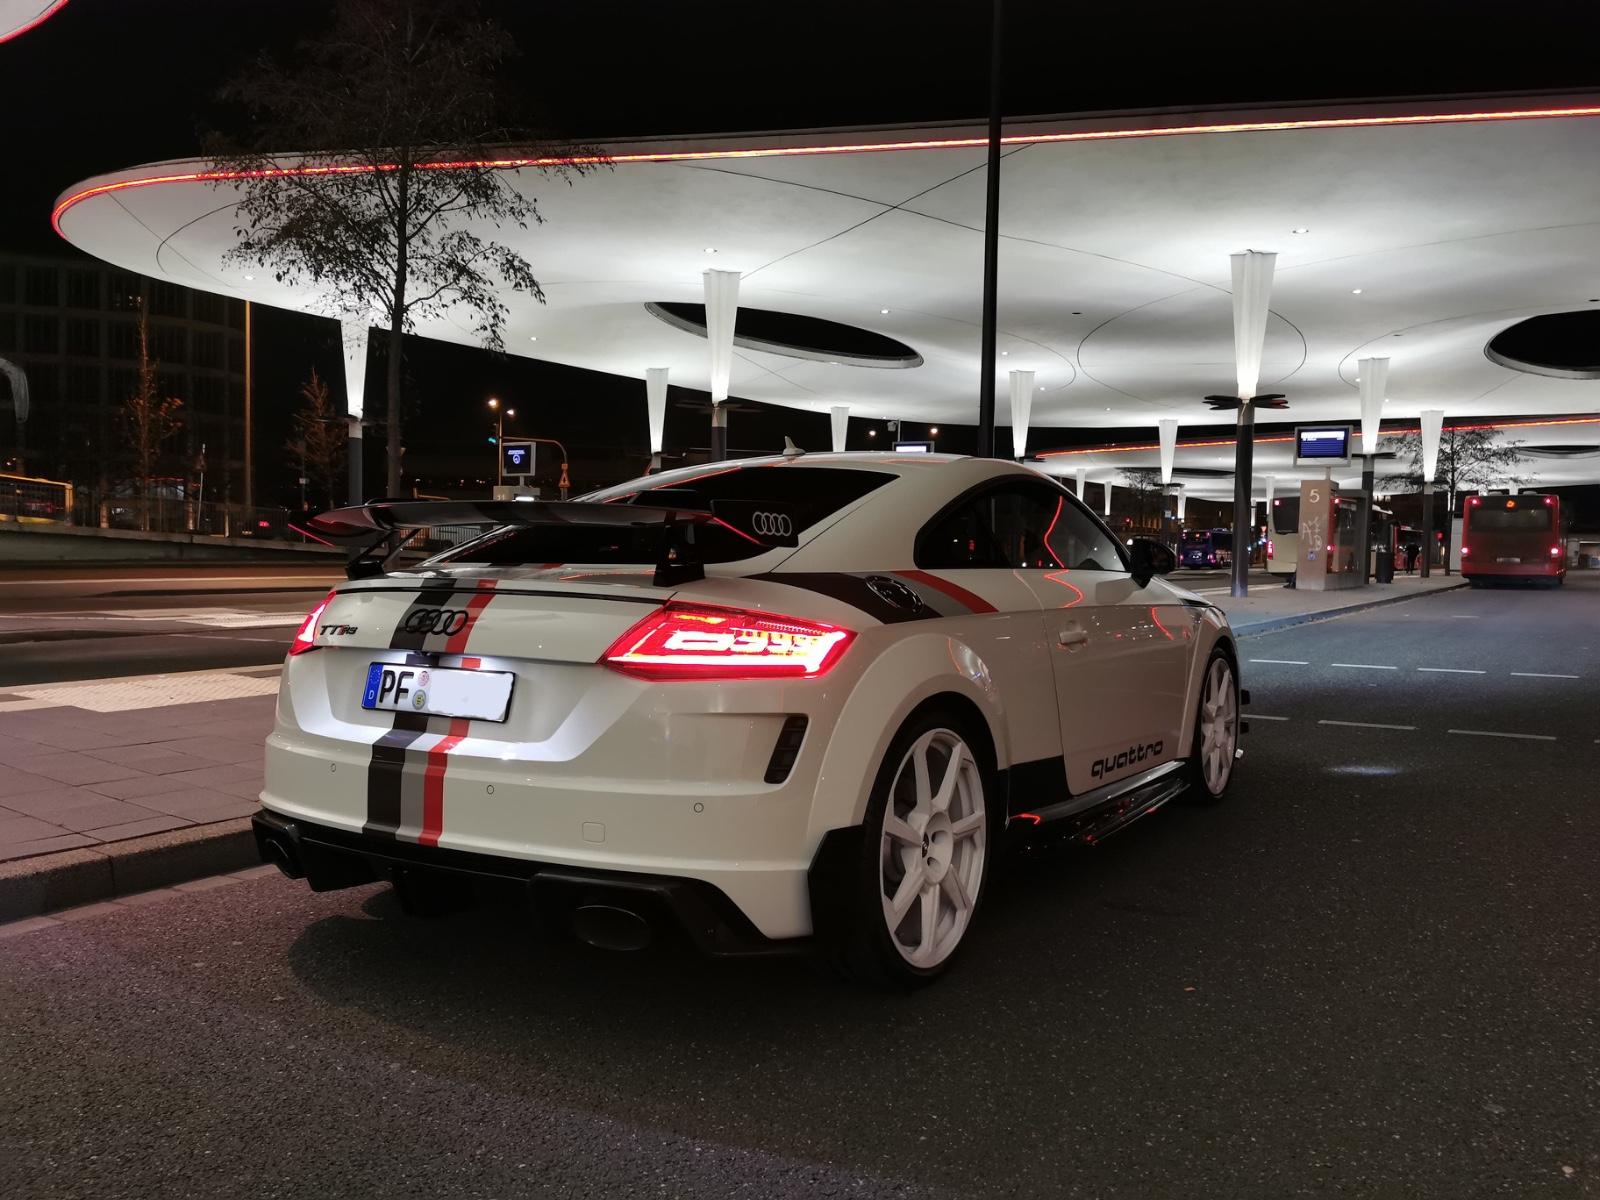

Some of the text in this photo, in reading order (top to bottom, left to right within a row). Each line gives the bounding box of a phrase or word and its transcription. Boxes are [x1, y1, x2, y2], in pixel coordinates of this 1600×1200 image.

[1309, 488, 1320, 503] 5
[368, 689, 375, 700] D
[378, 669, 415, 705] PF
[1091, 740, 1164, 780] quattro
